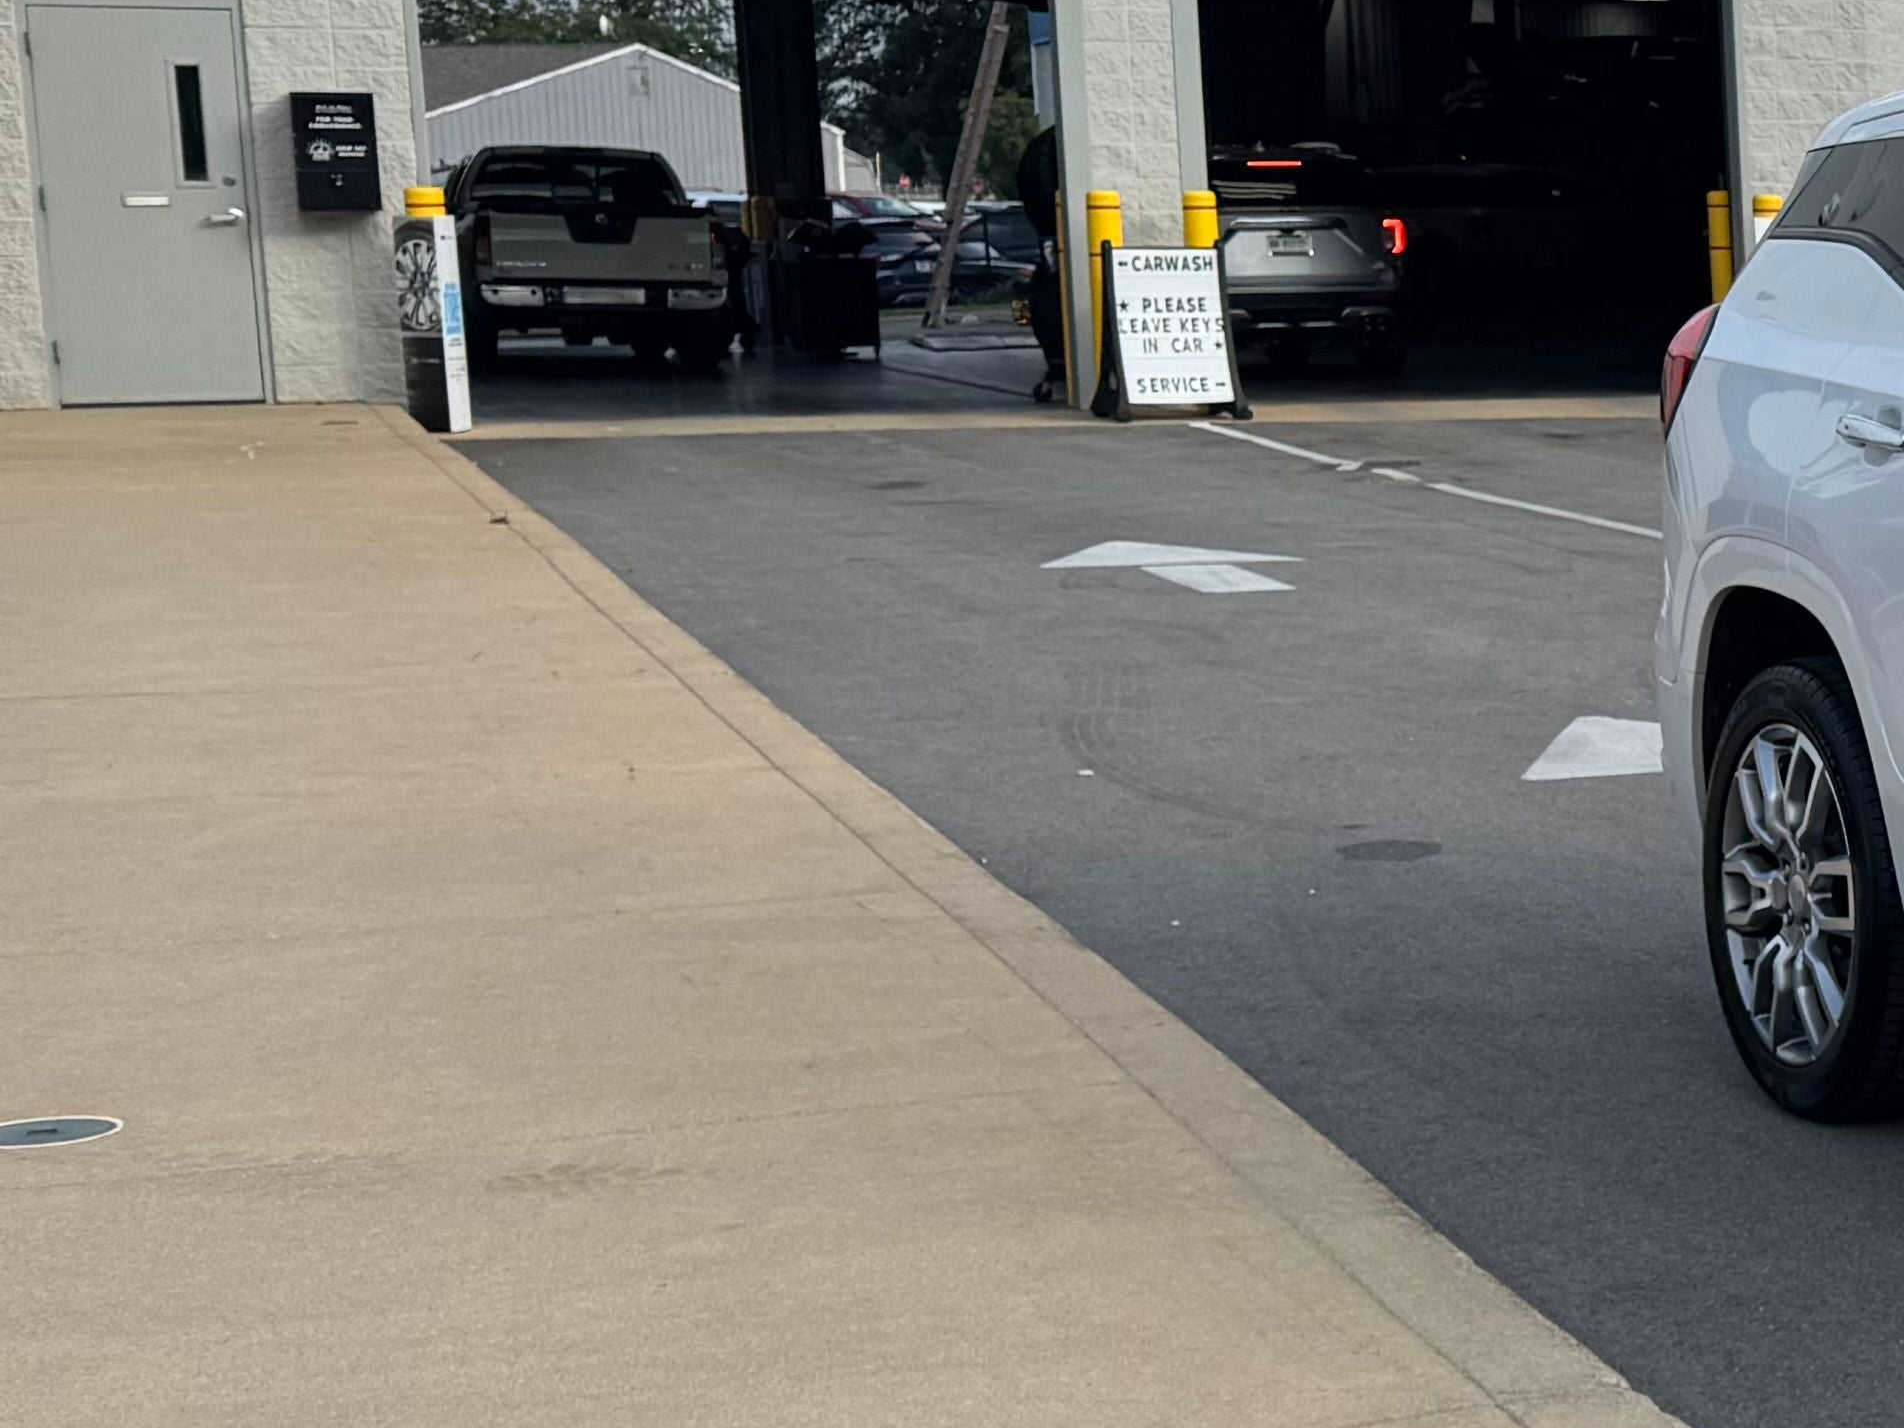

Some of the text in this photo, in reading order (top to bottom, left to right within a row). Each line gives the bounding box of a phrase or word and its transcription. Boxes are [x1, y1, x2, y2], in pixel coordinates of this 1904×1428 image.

[1131, 256, 1214, 272] CARWASH
[1142, 297, 1208, 314] PLEASE
[1119, 317, 1225, 334] LEAVE KEYS
[1143, 337, 1204, 354] IN CAR
[1136, 376, 1211, 393] SERVICE
